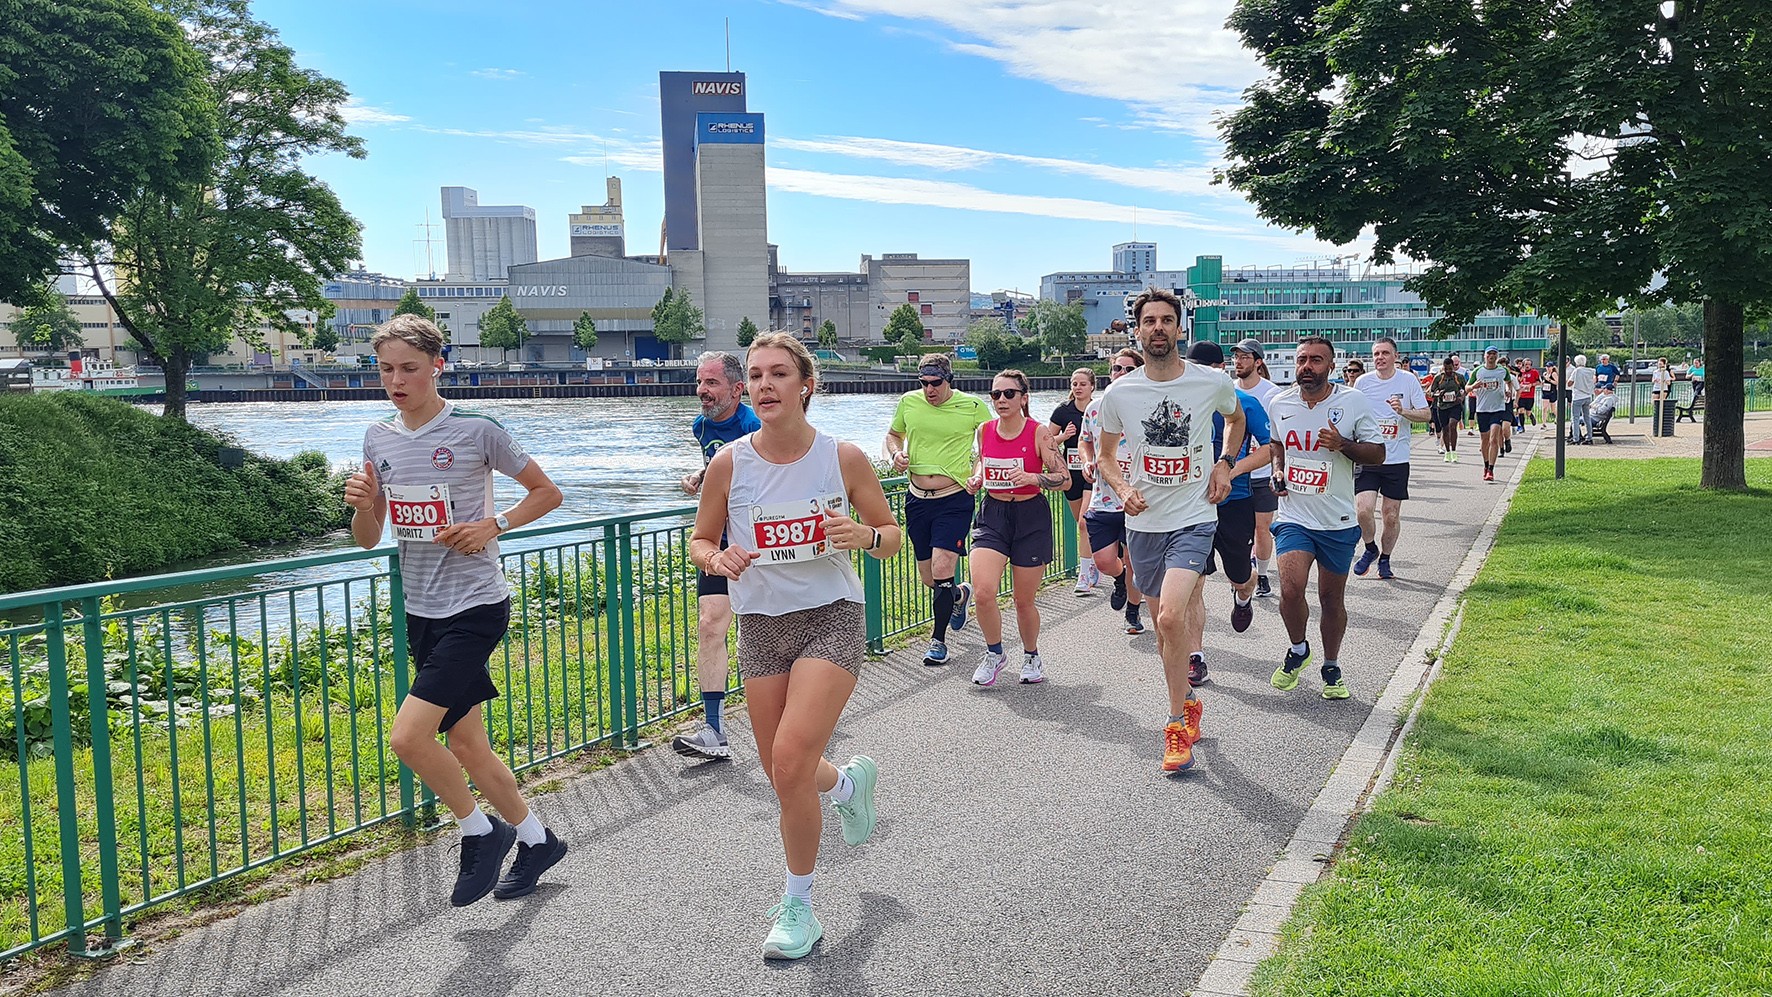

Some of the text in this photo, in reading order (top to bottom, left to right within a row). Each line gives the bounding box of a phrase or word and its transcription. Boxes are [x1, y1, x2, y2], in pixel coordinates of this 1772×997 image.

[694, 82, 741, 94] NAVIS
[516, 285, 568, 297] NAVIS
[1182, 446, 1189, 457] 3
[1148, 458, 1185, 474] 3512
[1193, 465, 1202, 478] 3
[1320, 461, 1327, 471] 3
[988, 468, 1009, 480] 370
[1147, 474, 1174, 485] THIERRY
[1291, 469, 1323, 485] 3097
[430, 485, 441, 500] 3
[810, 498, 820, 514] 3
[394, 504, 438, 524] 3980
[396, 527, 424, 539] MORITZ
[763, 519, 816, 546] 3987
[770, 548, 796, 561] LYNN
